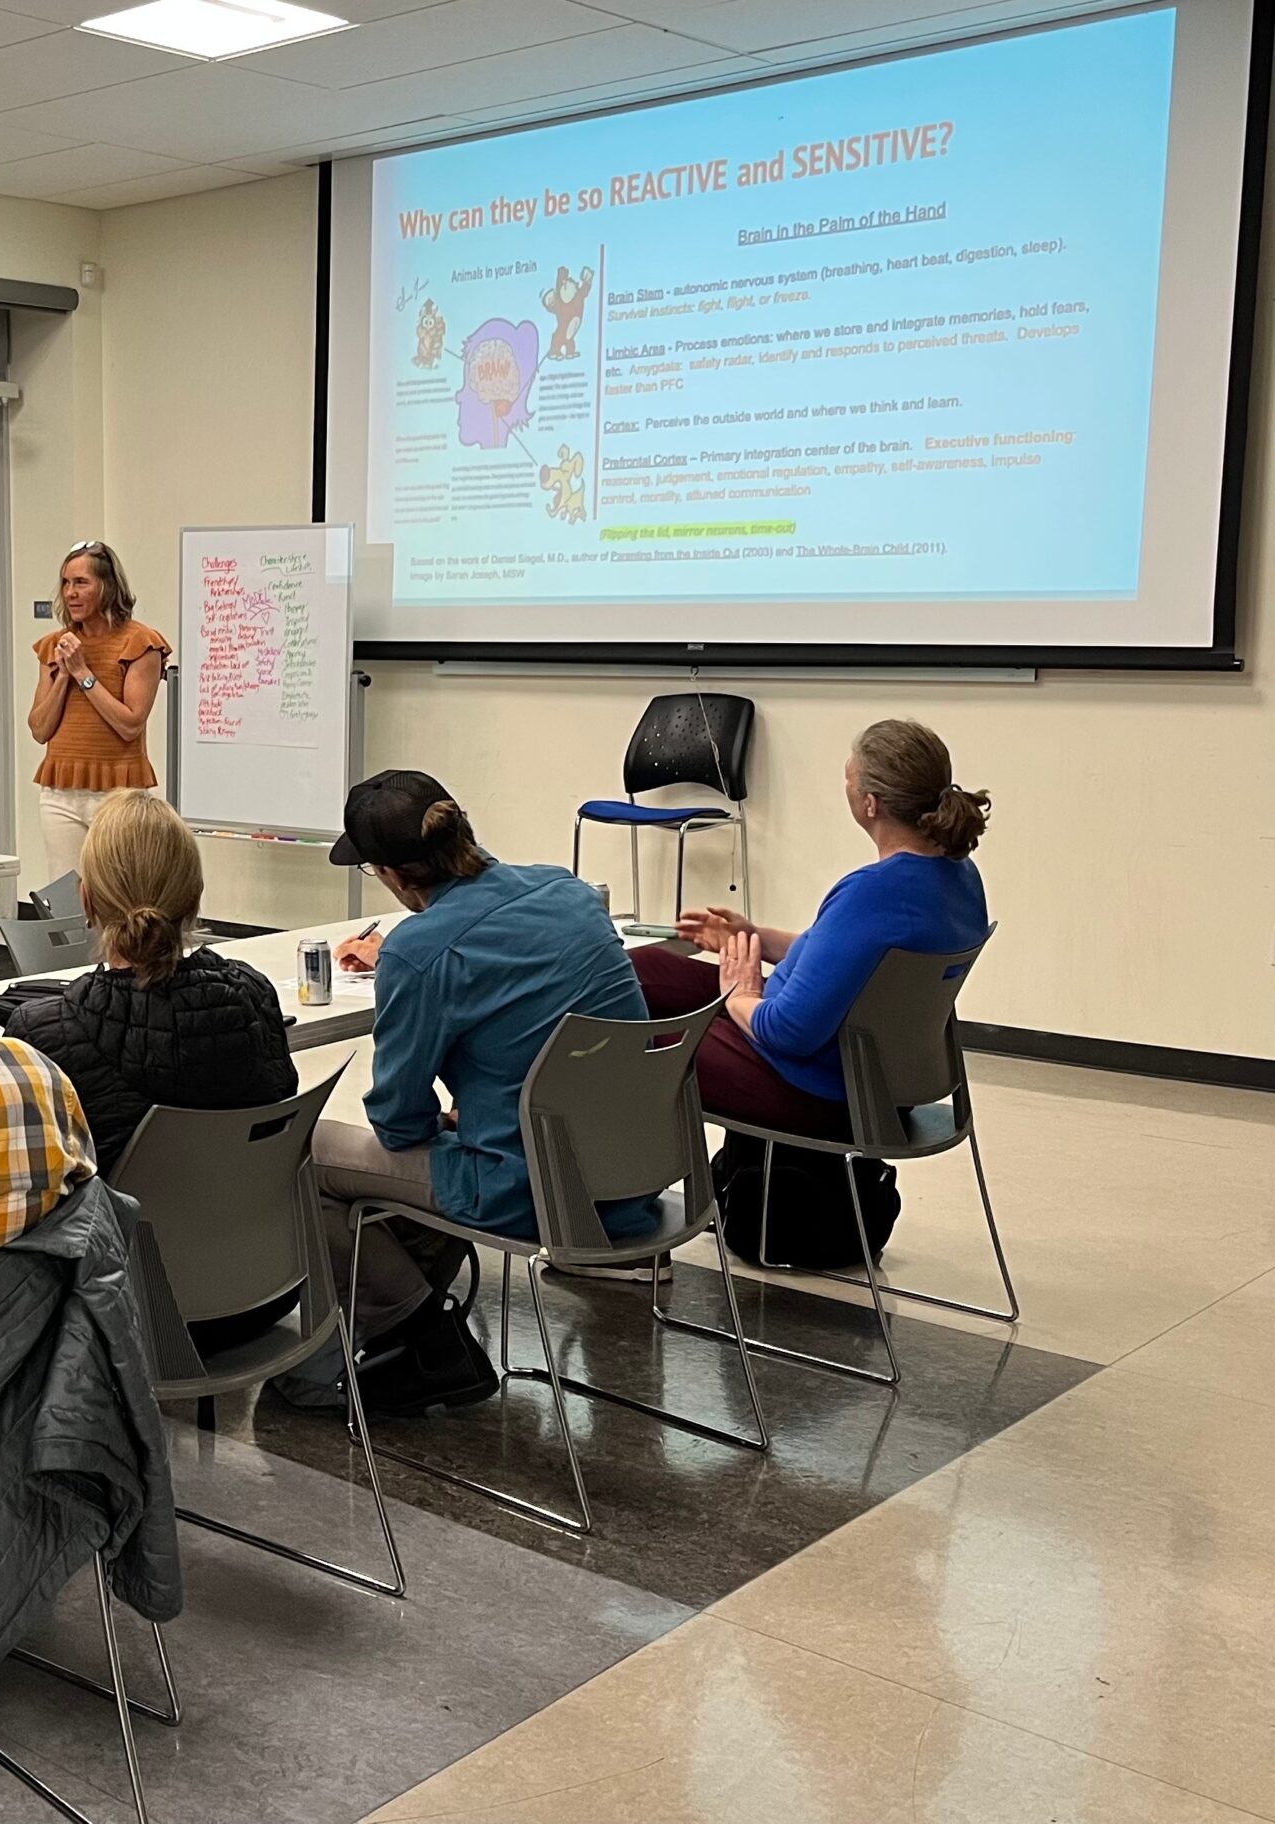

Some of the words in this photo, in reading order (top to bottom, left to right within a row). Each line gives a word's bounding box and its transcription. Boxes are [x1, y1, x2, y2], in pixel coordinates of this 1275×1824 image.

[399, 210, 442, 241] Why
[449, 207, 483, 232] can
[491, 197, 537, 227] they
[544, 189, 569, 216] be
[578, 188, 602, 212] so
[610, 159, 727, 206] REACTIVE
[737, 150, 784, 187] and
[792, 120, 954, 179] SENSITIVE?
[738, 228, 772, 245] Brain
[777, 225, 788, 240] in
[793, 221, 814, 237] the
[819, 216, 855, 233] Palm
[860, 212, 874, 227] of
[878, 210, 900, 224] the
[906, 202, 946, 221] Hand
[451, 269, 483, 283] Animals
[486, 267, 492, 278] in
[495, 264, 512, 280] your
[515, 261, 537, 274] Brain
[608, 291, 634, 305] Brain
[637, 289, 663, 301] Stem
[674, 280, 728, 296] autonomic
[731, 275, 774, 289] nervous
[778, 269, 817, 285] system
[821, 261, 883, 281] (breathing,
[887, 255, 918, 271] heart
[922, 251, 952, 266] beat,
[956, 244, 1017, 263] digestion,
[1021, 238, 1066, 254] sleep).
[608, 306, 648, 321] Survival
[759, 297, 770, 306] or
[774, 290, 810, 304] freeze.
[606, 347, 639, 360] Limbic
[641, 343, 665, 356] Area
[675, 339, 718, 352] Process
[721, 333, 773, 347] emotions:
[777, 329, 811, 342] where
[814, 328, 830, 338] we
[834, 323, 863, 336] store
[866, 320, 889, 333] and
[892, 316, 945, 331] integrate
[949, 307, 1015, 325] memories,
[1019, 303, 1048, 318] hold
[1052, 300, 1090, 315] fears,
[606, 367, 623, 377] etc.
[690, 356, 720, 370] safety
[724, 354, 755, 366] radar,
[759, 348, 798, 363] identify
[801, 345, 822, 358] and
[884, 341, 894, 352] to
[898, 335, 957, 352] perceived
[961, 329, 1008, 344] threats.
[1017, 324, 1079, 340] Develops
[605, 384, 633, 395] faster
[636, 382, 657, 393] than
[661, 378, 684, 390] PFC
[604, 421, 639, 433] Cortex:
[646, 416, 690, 429] Perceive
[693, 414, 709, 425] the
[713, 411, 751, 424] outside
[754, 408, 784, 421] world
[787, 407, 808, 418] and
[812, 404, 846, 416] where
[850, 404, 866, 414] we
[870, 400, 898, 413] think
[901, 398, 924, 410] and
[928, 397, 962, 408] learn.
[603, 457, 650, 469] Prefrontal
[654, 454, 687, 466] Cortex
[700, 450, 741, 463] Primary
[744, 447, 801, 461] integration
[805, 445, 841, 456] center
[844, 444, 857, 454] of
[859, 442, 876, 453] the
[880, 440, 912, 452] brain.
[925, 435, 989, 450] Executive
[601, 475, 653, 488] reasoning,
[717, 468, 769, 481] emotional
[772, 465, 830, 479] regulation,
[834, 463, 886, 477] empathy,
[891, 457, 987, 472] self-awareness,
[992, 453, 1041, 467] impulse
[686, 487, 726, 501] attuned
[729, 484, 811, 498] communication
[640, 529, 655, 538] the
[673, 526, 704, 537] mirror
[706, 524, 748, 536] neurons,
[202, 557, 237, 574] Challenges
[447, 556, 459, 565] the
[461, 555, 479, 564] work
[482, 555, 490, 564] of
[492, 555, 516, 564] Daniel
[572, 552, 598, 562] author
[600, 552, 609, 561] of
[611, 551, 651, 562] Parenting
[655, 550, 674, 560] from
[677, 550, 691, 560] the
[693, 549, 721, 559] Inside
[724, 548, 740, 558] Out
[742, 546, 773, 558] (2003)
[775, 547, 793, 557] and
[796, 546, 815, 557] The
[818, 544, 879, 555] Whole-Brain
[882, 543, 910, 554] Child
[911, 542, 947, 555] (2011).
[435, 571, 444, 582] by
[446, 570, 468, 580] Sarah
[503, 569, 525, 578] MSW
